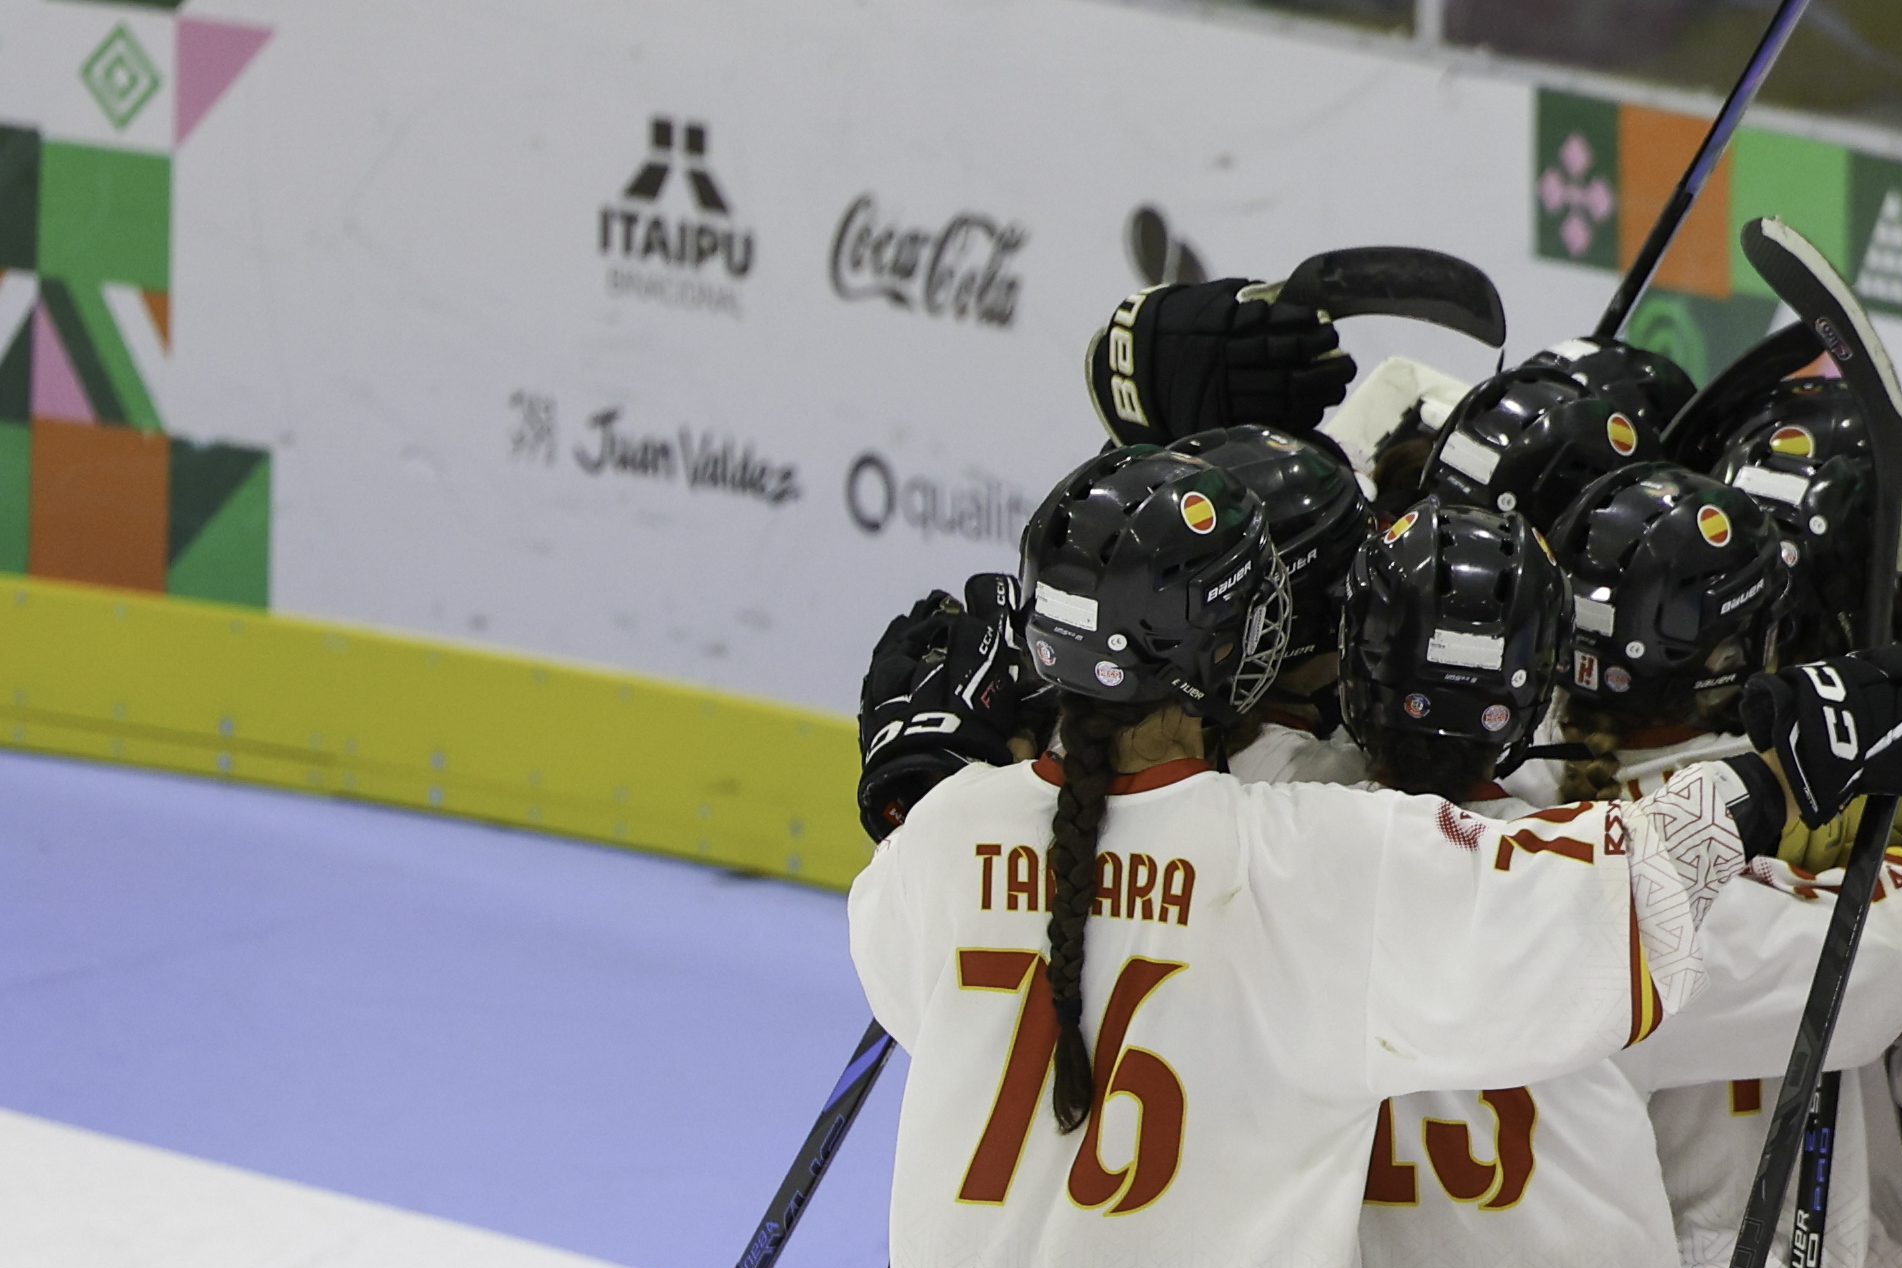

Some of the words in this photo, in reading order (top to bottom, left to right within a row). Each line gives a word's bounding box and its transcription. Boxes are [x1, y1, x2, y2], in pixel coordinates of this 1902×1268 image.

[598, 208, 757, 278] ITAIPU
[1108, 281, 1163, 429] BAU
[575, 407, 676, 476] Juan
[676, 425, 803, 504] Valdez
[1207, 559, 1252, 603] BAUER
[974, 842, 1196, 927] TAARA
[954, 946, 1190, 1217] 76
